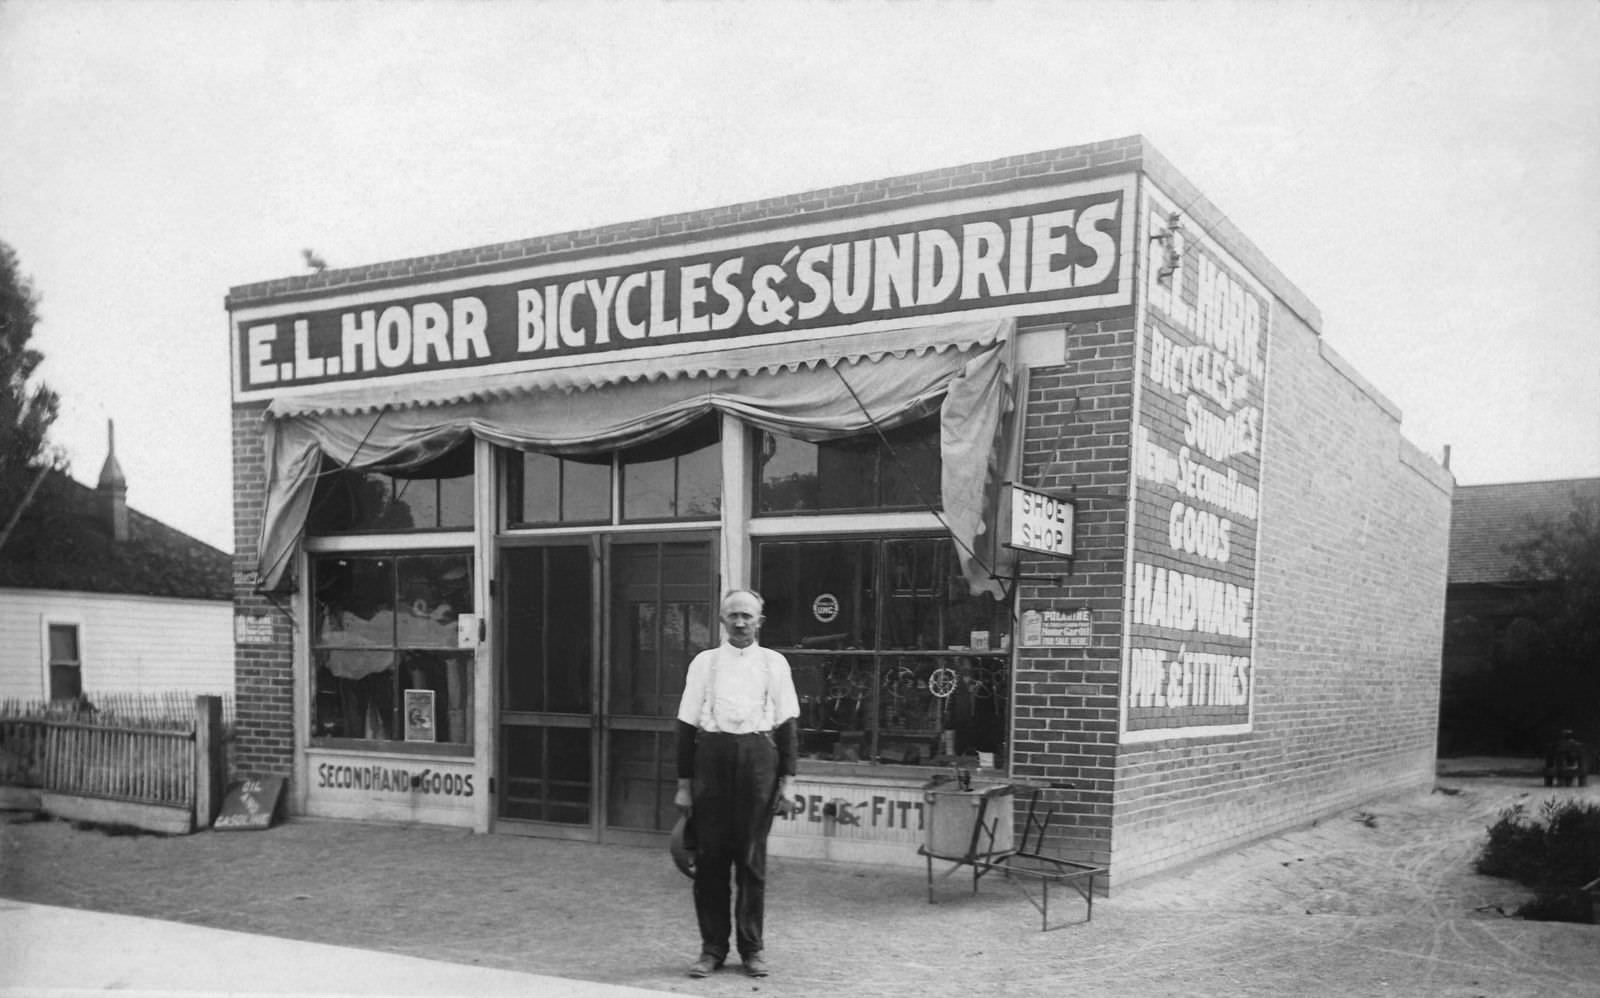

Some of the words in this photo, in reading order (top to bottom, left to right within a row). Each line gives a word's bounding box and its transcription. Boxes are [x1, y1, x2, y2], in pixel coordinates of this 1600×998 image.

[516, 256, 744, 354] BICYCLES
[796, 198, 1120, 321] SUNDRIES
[1150, 325, 1235, 411] BICYCLES
[1183, 394, 1260, 462] SUNDRIES
[1023, 492, 1065, 524] SHOE
[1023, 522, 1063, 551] SHOP
[1169, 501, 1231, 562] GOODS
[1134, 562, 1252, 639] HARDWARE
[1129, 648, 1167, 708] PIPE
[1183, 651, 1249, 706] FITTINGS
[241, 780, 263, 793] OIL
[317, 762, 410, 793] SECONDHAND
[419, 768, 475, 798] GOODS
[871, 795, 925, 831] FITT
